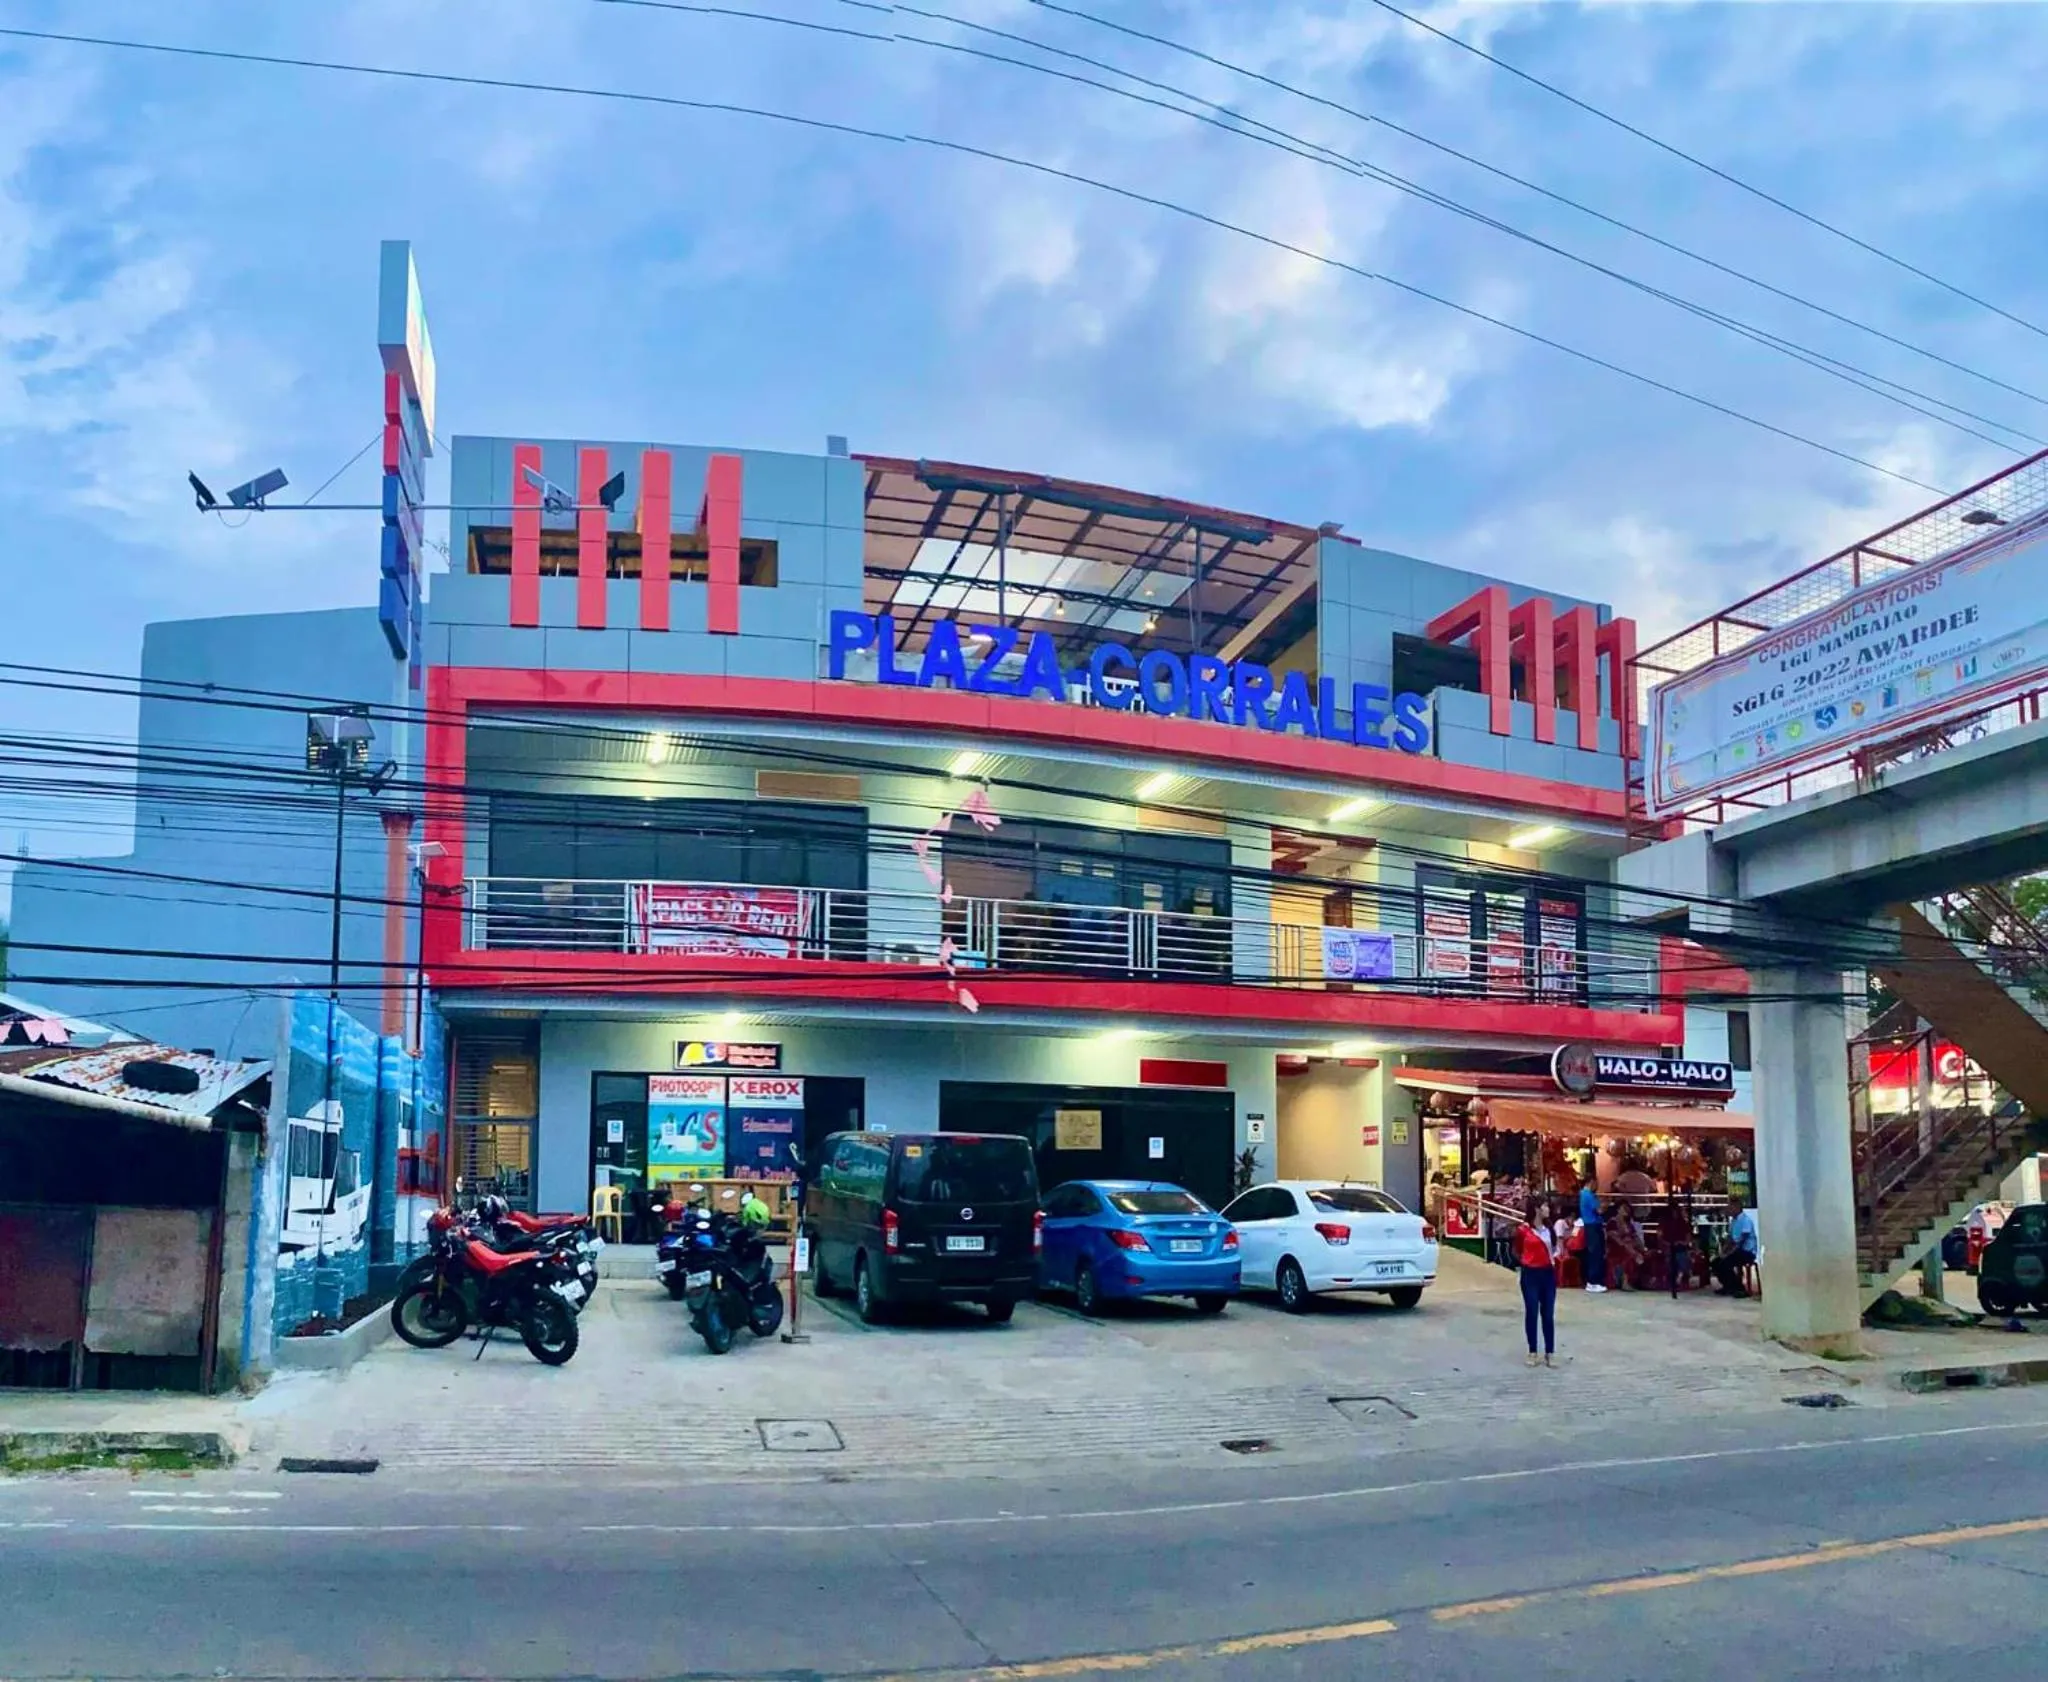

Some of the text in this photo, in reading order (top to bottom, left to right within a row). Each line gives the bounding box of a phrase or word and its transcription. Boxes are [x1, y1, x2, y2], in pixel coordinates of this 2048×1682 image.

[1758, 572, 1943, 664] CONGRATULATIONS!
[1779, 604, 1919, 673] LGU MAMBAJAO
[830, 609, 1431, 754] PLAZA CORRALES
[1731, 682, 1785, 719] SGLG
[1793, 656, 1851, 695] 2022
[1858, 604, 1980, 666] AWARDEE
[651, 1079, 721, 1093] PHOTOCOPY
[733, 1081, 800, 1095] XEROX
